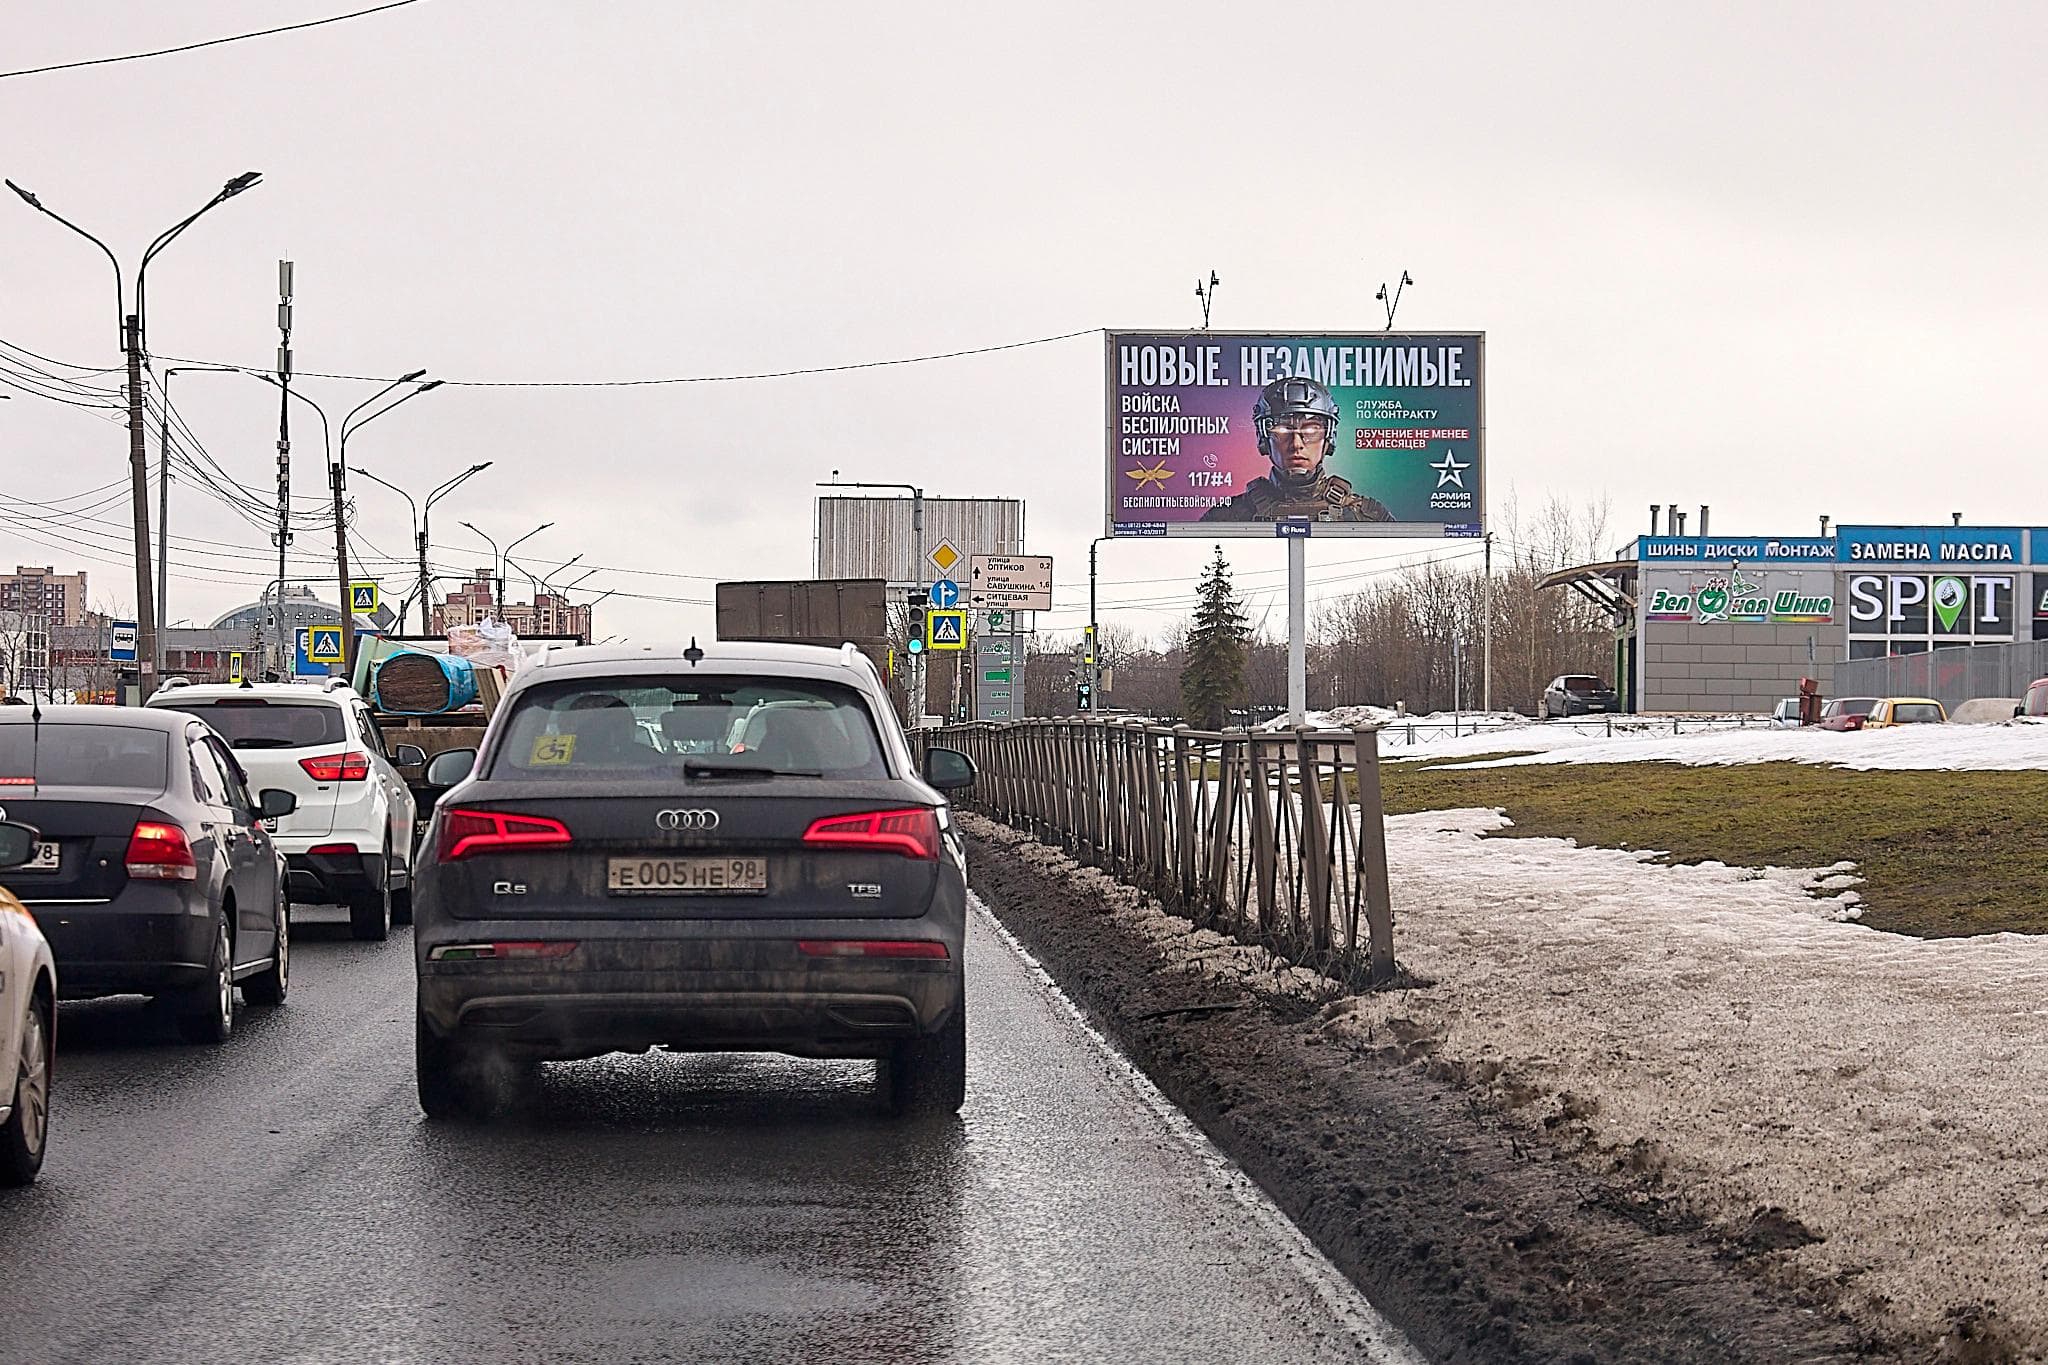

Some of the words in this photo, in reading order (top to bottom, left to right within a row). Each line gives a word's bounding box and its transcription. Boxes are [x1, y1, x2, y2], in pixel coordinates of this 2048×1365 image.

[1120, 345, 1229, 387] НОВЫЕ.
[1240, 346, 1471, 387] НЕЗАМЕНИМЫЕ.
[1122, 392, 1180, 413] ВОЙСКА
[1356, 400, 1402, 410] СЛУЖБА
[1356, 410, 1371, 419] ПО
[1374, 410, 1438, 419] КОНТРАКТУ
[1122, 416, 1230, 434] БЕСПИЛОТНЫХ
[1356, 429, 1413, 439] ОБУЧЕНИЕ
[1415, 429, 1430, 439] НЕ
[1431, 429, 1469, 439] МЕНЕЕ
[1122, 437, 1180, 456] СИСТЕМ
[1375, 439, 1426, 450] МЕСЯЦЕВ
[1188, 471, 1232, 487] 117#4
[1123, 495, 1232, 508] БЕСПИЛОТНЫЕВОЙСКА.РФ
[1430, 492, 1471, 500] АРМИЯ
[1430, 501, 1471, 509] РОССИИ
[1648, 544, 1698, 556] ШИНЫ
[1704, 544, 1758, 557] ДИСКИ
[1765, 545, 1835, 556] МОНТАЖ
[1851, 543, 1931, 560] ЗАМЕНА
[1941, 543, 2013, 560] МАСЛА
[986, 593, 1029, 601] СИТЦЕВАЯ
[1773, 592, 1833, 613] Шина
[1850, 574, 2012, 632] SPOT
[494, 881, 527, 894] Q5
[848, 884, 881, 893] TFSI
